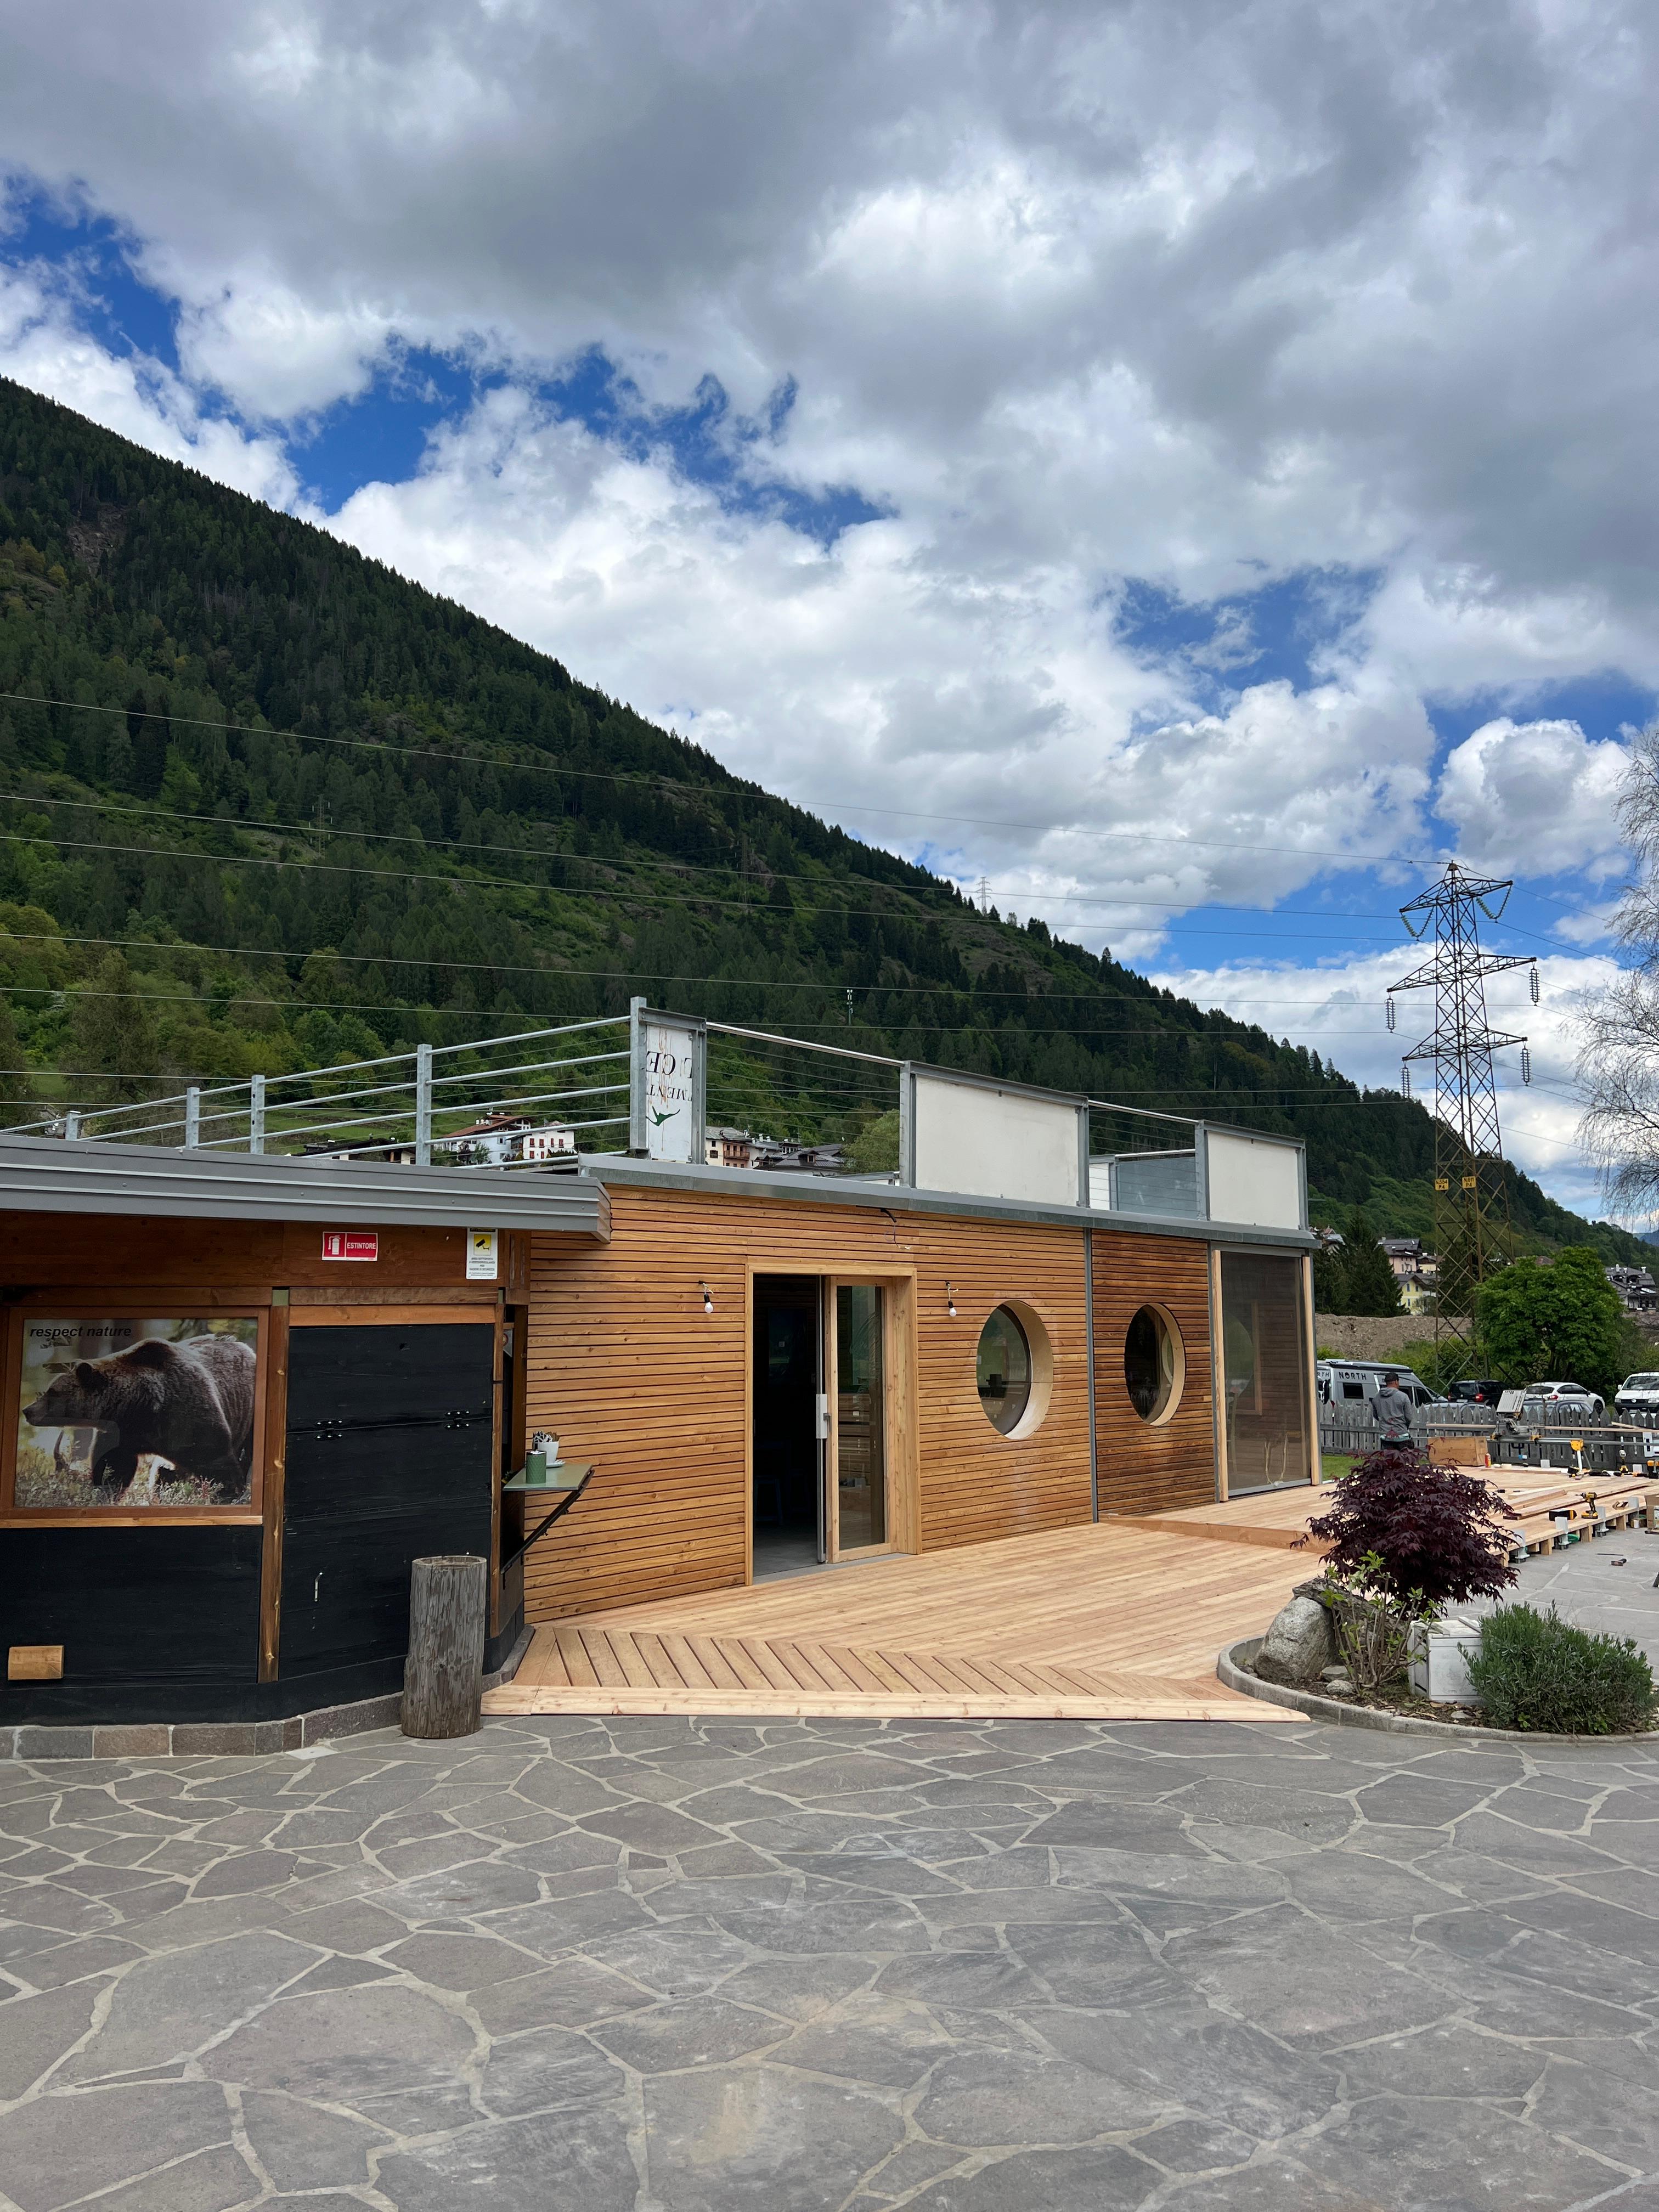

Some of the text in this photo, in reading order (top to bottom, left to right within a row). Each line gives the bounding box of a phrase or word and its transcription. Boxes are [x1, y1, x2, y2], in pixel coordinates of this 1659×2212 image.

[30, 1326, 131, 1339] respect nature
[1339, 1372, 1367, 1380] NORTH
